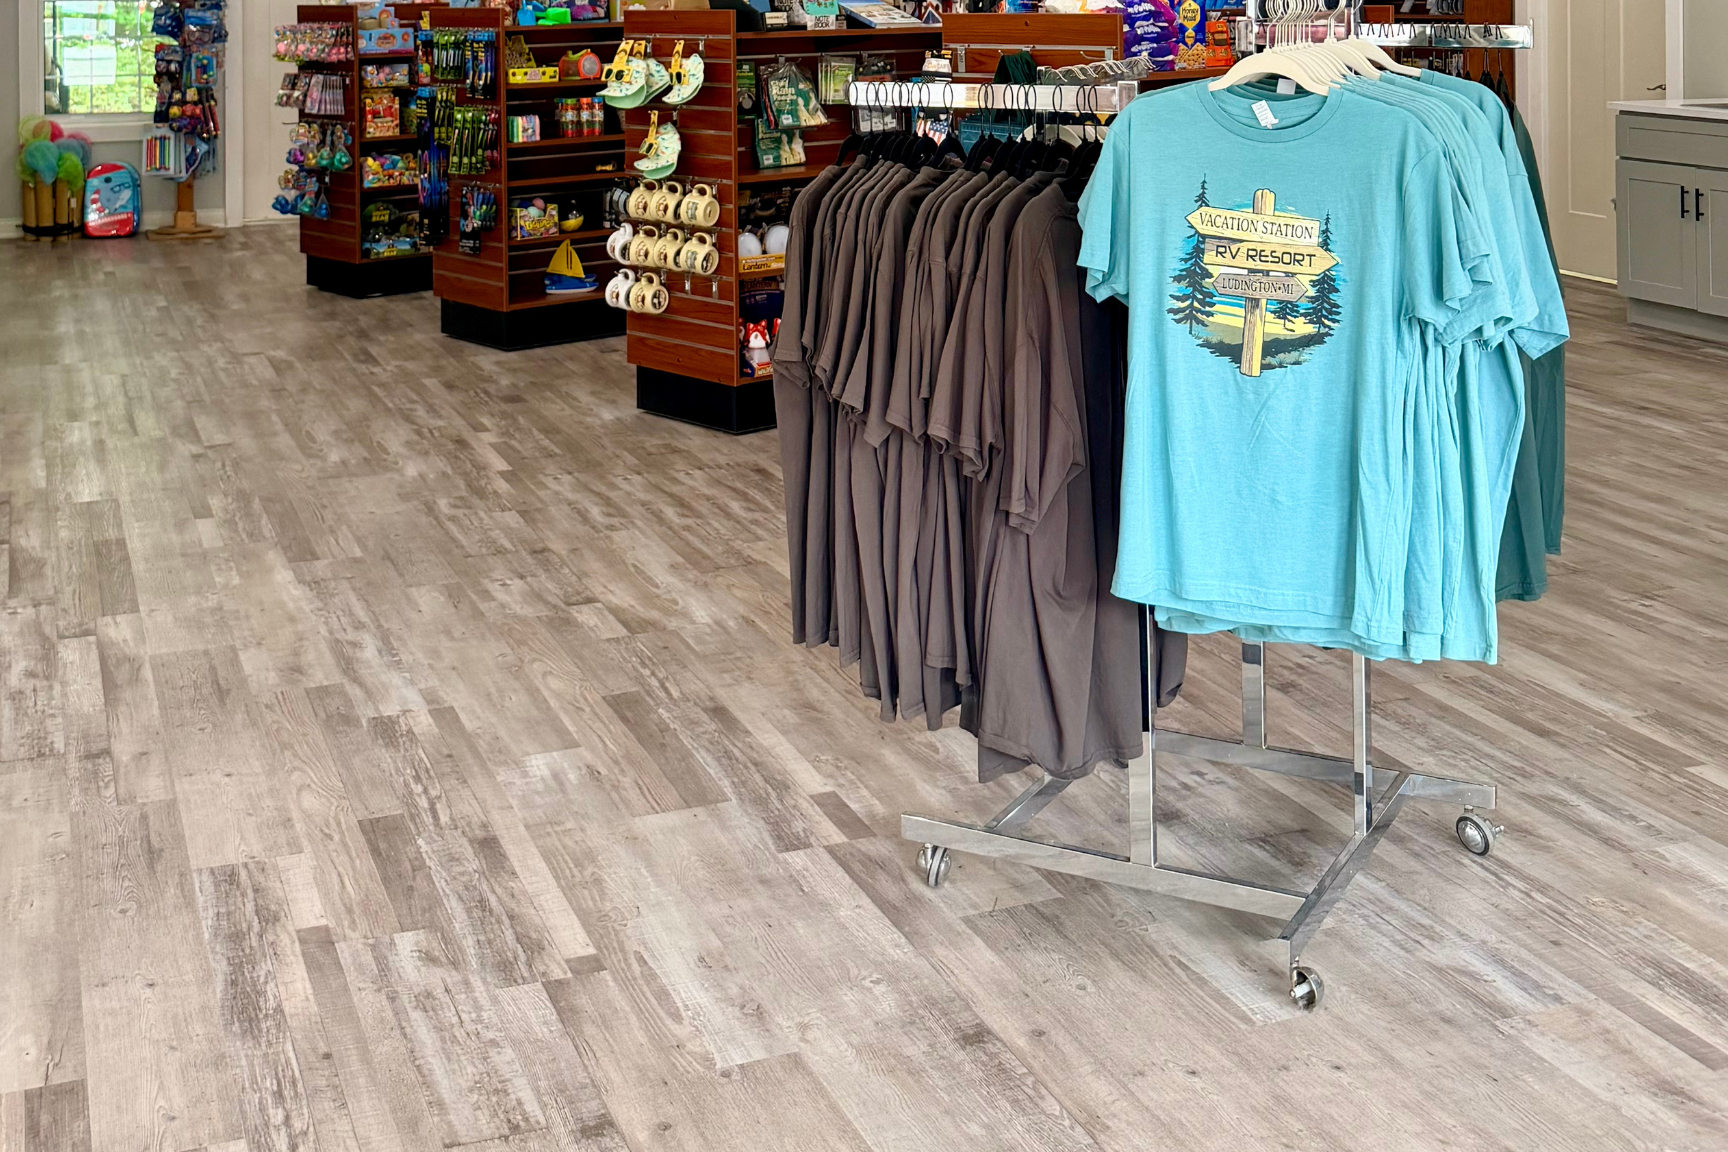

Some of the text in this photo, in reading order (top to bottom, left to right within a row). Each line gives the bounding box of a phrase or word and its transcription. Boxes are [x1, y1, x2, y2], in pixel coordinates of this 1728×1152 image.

[1182, 7, 1198, 15] Honey
[1199, 212, 1314, 239] VACATION STATION
[1215, 245, 1316, 267] RV RESORT
